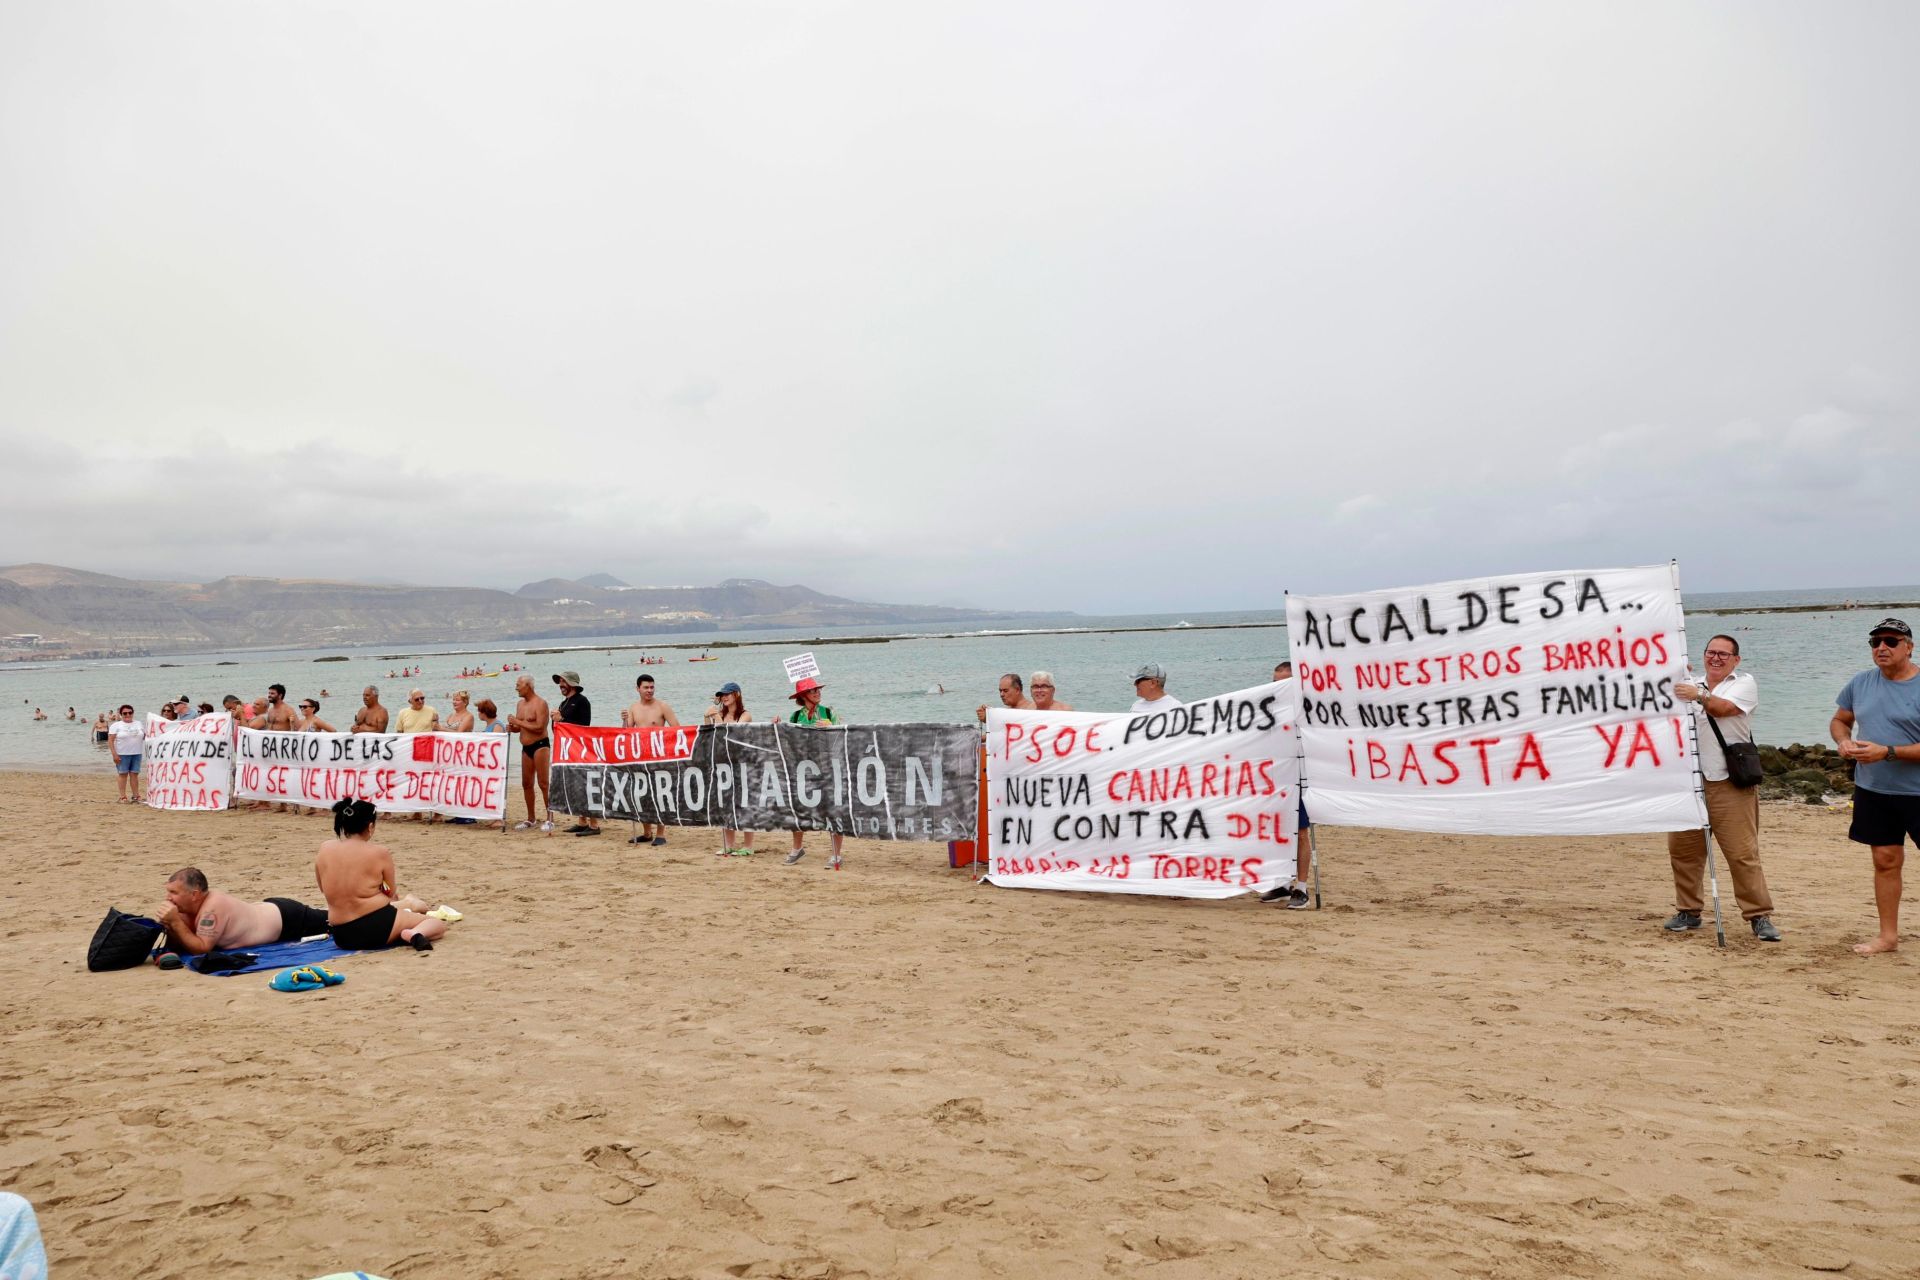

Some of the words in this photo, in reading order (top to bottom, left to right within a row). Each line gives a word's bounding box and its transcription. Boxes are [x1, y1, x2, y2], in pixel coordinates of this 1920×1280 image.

[1299, 662, 1342, 692] POR
[1355, 645, 1522, 691] NUESTROS
[1542, 625, 1668, 672] BARRIOS
[1302, 697, 1348, 727] POR
[1358, 690, 1520, 729] NUESTRAS
[1541, 674, 1674, 716] FAMILIAS
[154, 741, 170, 758] SE
[242, 734, 254, 758] EL
[262, 735, 319, 761] BARRIO
[330, 739, 355, 761] DE
[362, 738, 398, 761] LAS
[559, 729, 690, 761] NINGUNA
[1595, 718, 1685, 769] YA!
[155, 761, 207, 784] CASAS
[242, 763, 259, 791] NO
[266, 766, 289, 794] SE
[375, 768, 397, 800] SE
[403, 769, 500, 810] DEFIENDE
[586, 744, 944, 814] EXPROPIACIÓN
[812, 817, 844, 833] LAS
[855, 817, 953, 835] TORRES
[1001, 818, 1033, 845] EN
[1053, 809, 1210, 842] CONTRA
[1226, 812, 1289, 844] DEL
[1148, 854, 1264, 887] TORRES
